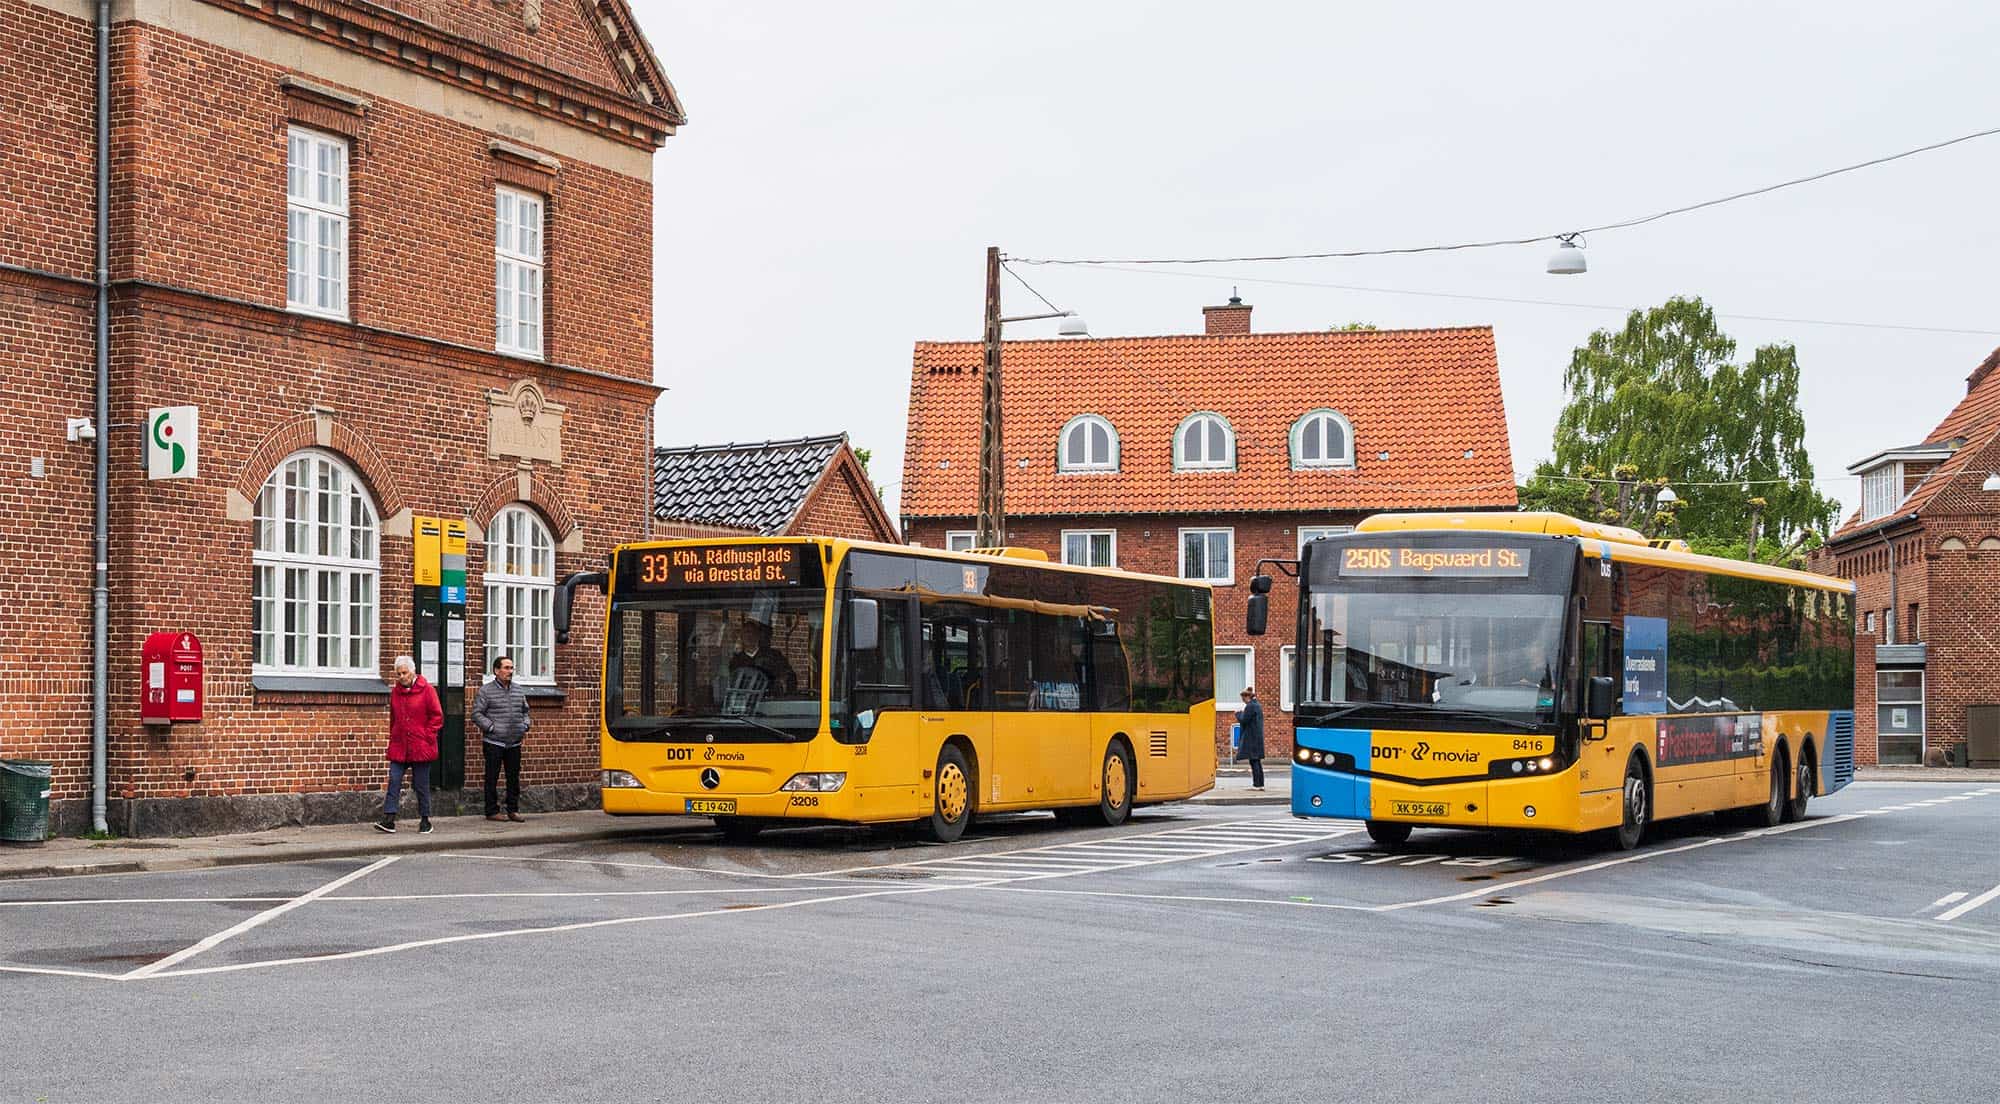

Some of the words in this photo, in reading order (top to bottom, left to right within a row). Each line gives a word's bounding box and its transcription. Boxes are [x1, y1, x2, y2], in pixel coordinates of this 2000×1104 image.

[642, 554, 668, 583] 33
[673, 551, 701, 566] Kbh.
[706, 548, 791, 566] Rådhusplads
[1346, 550, 1391, 569] 250S
[1400, 549, 1491, 571] Bagsværd
[1497, 549, 1521, 567] St.
[1600, 559, 1611, 577] bus
[685, 569, 703, 583] via
[709, 566, 761, 582] Ørestad
[766, 565, 785, 580] St.
[964, 572, 975, 589] 33
[1513, 739, 1543, 751] 8416
[667, 748, 694, 760] DOT
[716, 750, 745, 761] movia
[1372, 745, 1401, 760] DOT
[1432, 749, 1478, 762] movia
[692, 801, 704, 812] CE
[706, 801, 717, 812] 19
[718, 801, 735, 812] 420
[791, 796, 819, 807] 3208
[1397, 803, 1410, 814] XK
[1411, 803, 1426, 815] 95
[1307, 851, 1524, 867] BUS
